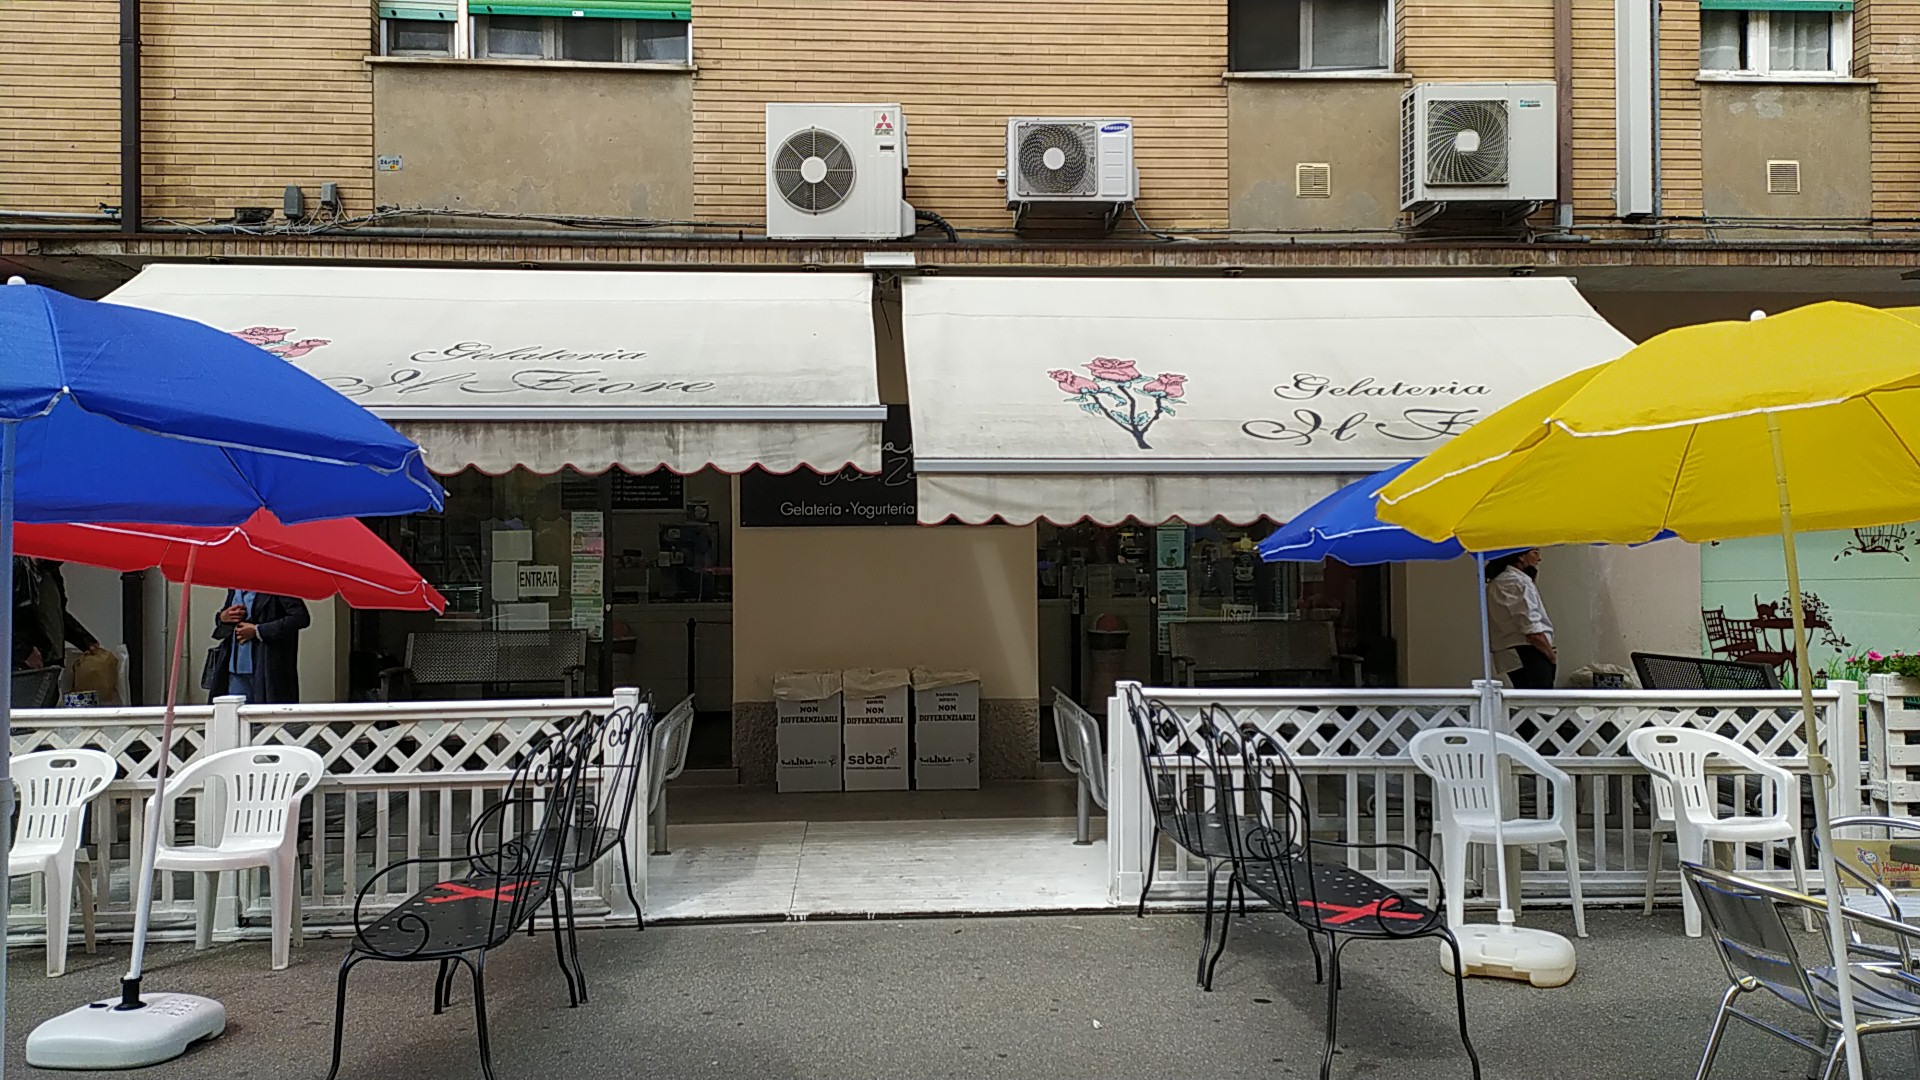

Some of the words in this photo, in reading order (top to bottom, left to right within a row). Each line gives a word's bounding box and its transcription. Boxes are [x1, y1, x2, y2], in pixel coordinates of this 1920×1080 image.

[409, 341, 648, 363] Gelateria
[459, 369, 718, 396] Fiore
[1273, 372, 1492, 401] Gelateria
[1241, 408, 1369, 447] Il
[780, 501, 842, 516] Gelateria
[850, 501, 915, 519] Yogurteria
[519, 571, 558, 587] ENTRATA
[780, 716, 838, 724] DIFFERENZIABILI
[846, 716, 904, 724] DIFFERENZIABILI
[919, 713, 976, 722] DIFFERENZIABILI
[848, 752, 890, 765] sabar
